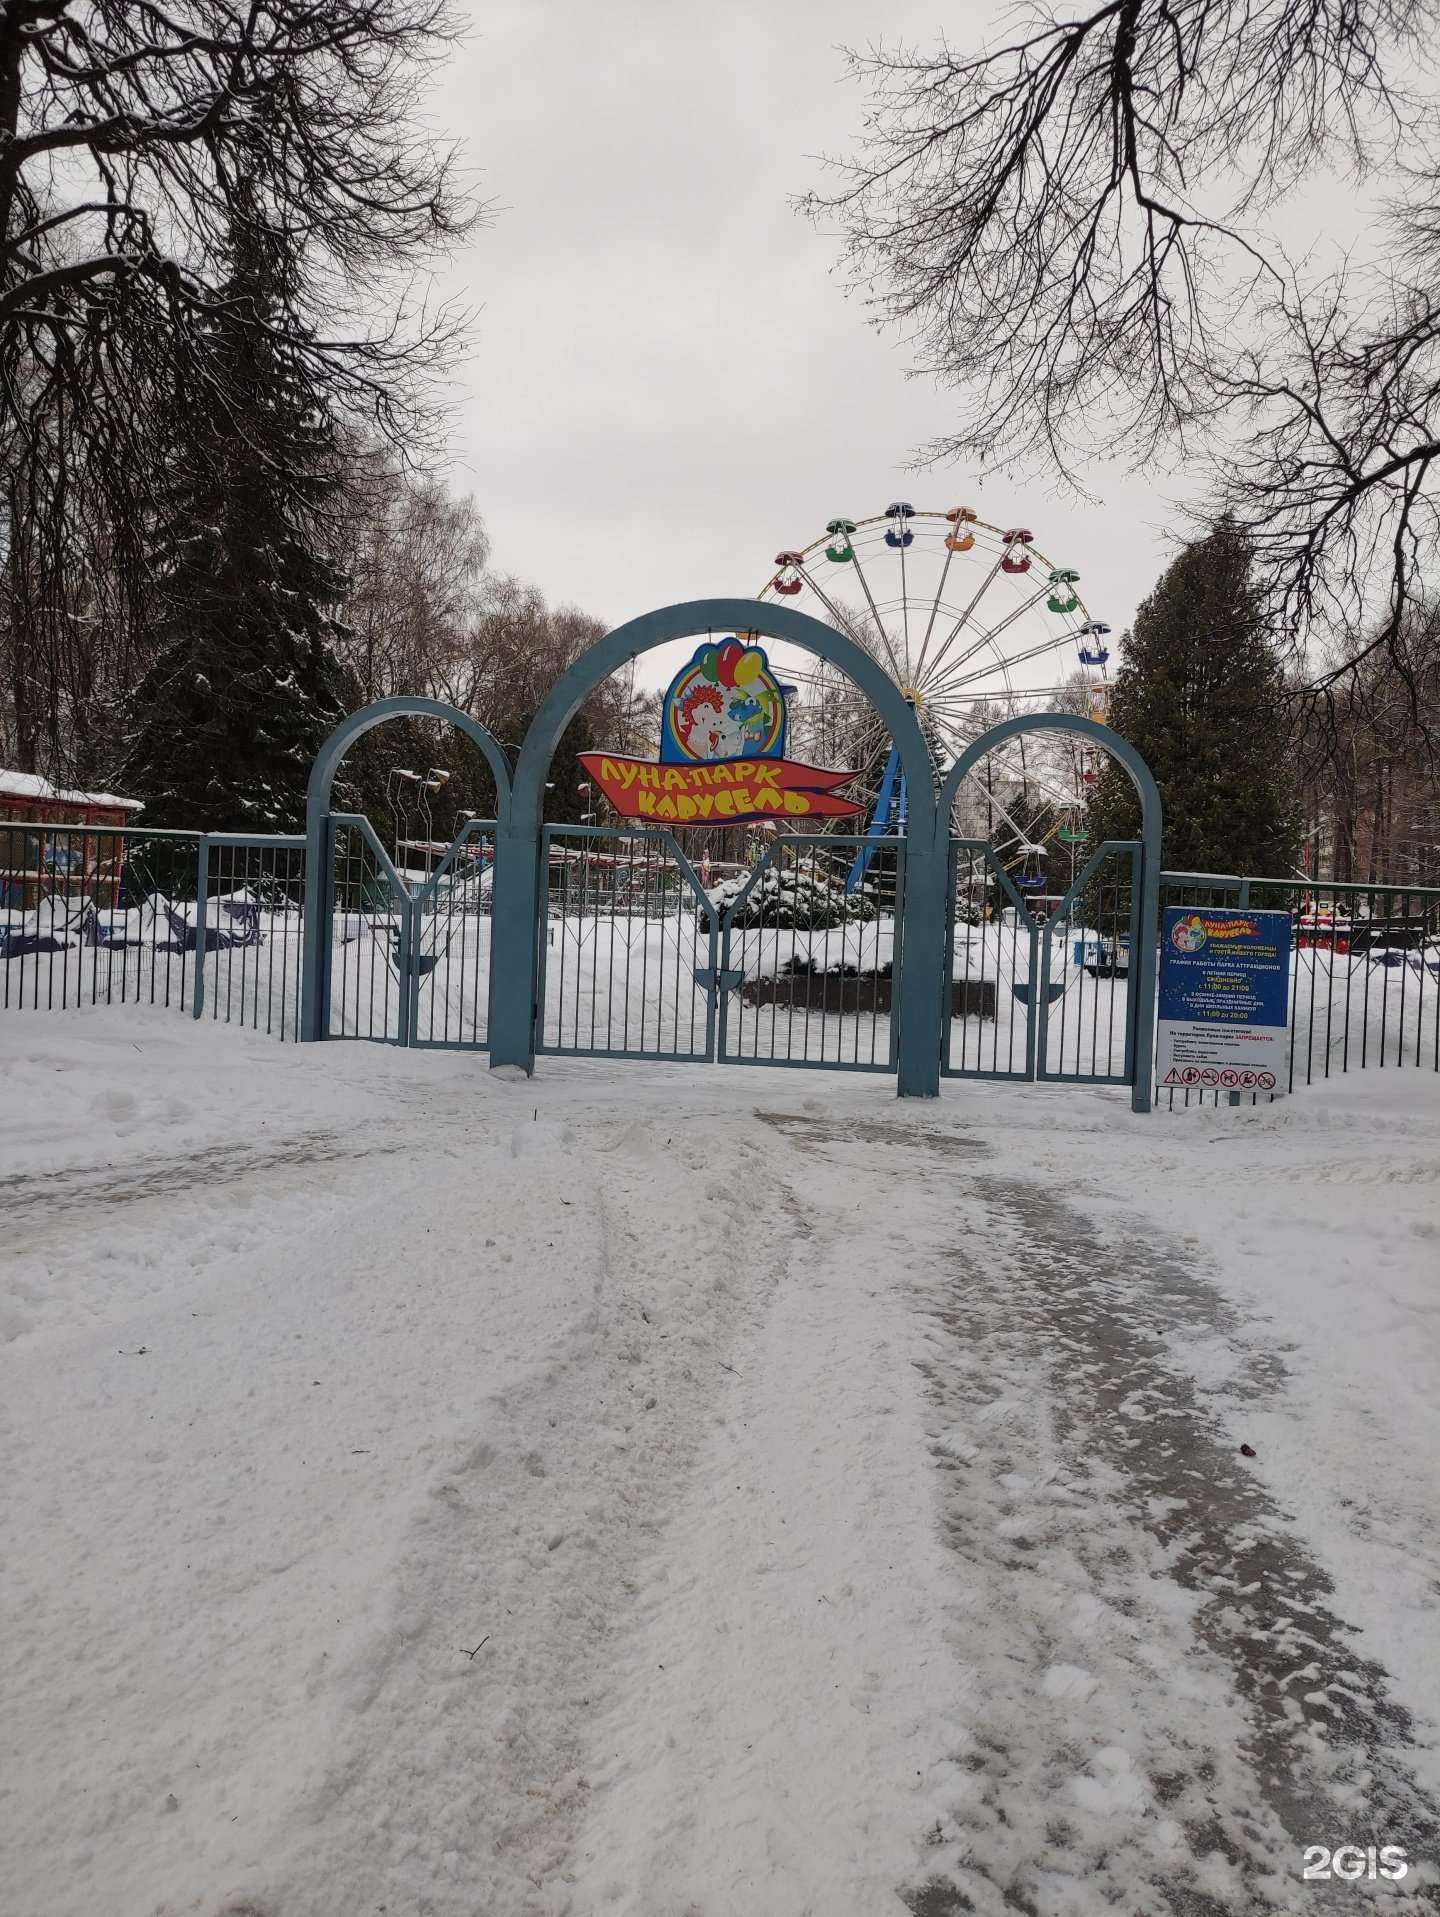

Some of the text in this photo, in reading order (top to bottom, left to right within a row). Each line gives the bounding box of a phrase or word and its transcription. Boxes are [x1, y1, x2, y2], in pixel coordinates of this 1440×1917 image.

[601, 758, 782, 791] ЛУНА-ПАРК
[638, 788, 811, 820] КАРУСЕЛЬ
[1208, 927, 1252, 938] КАРУСЕЛЬ
